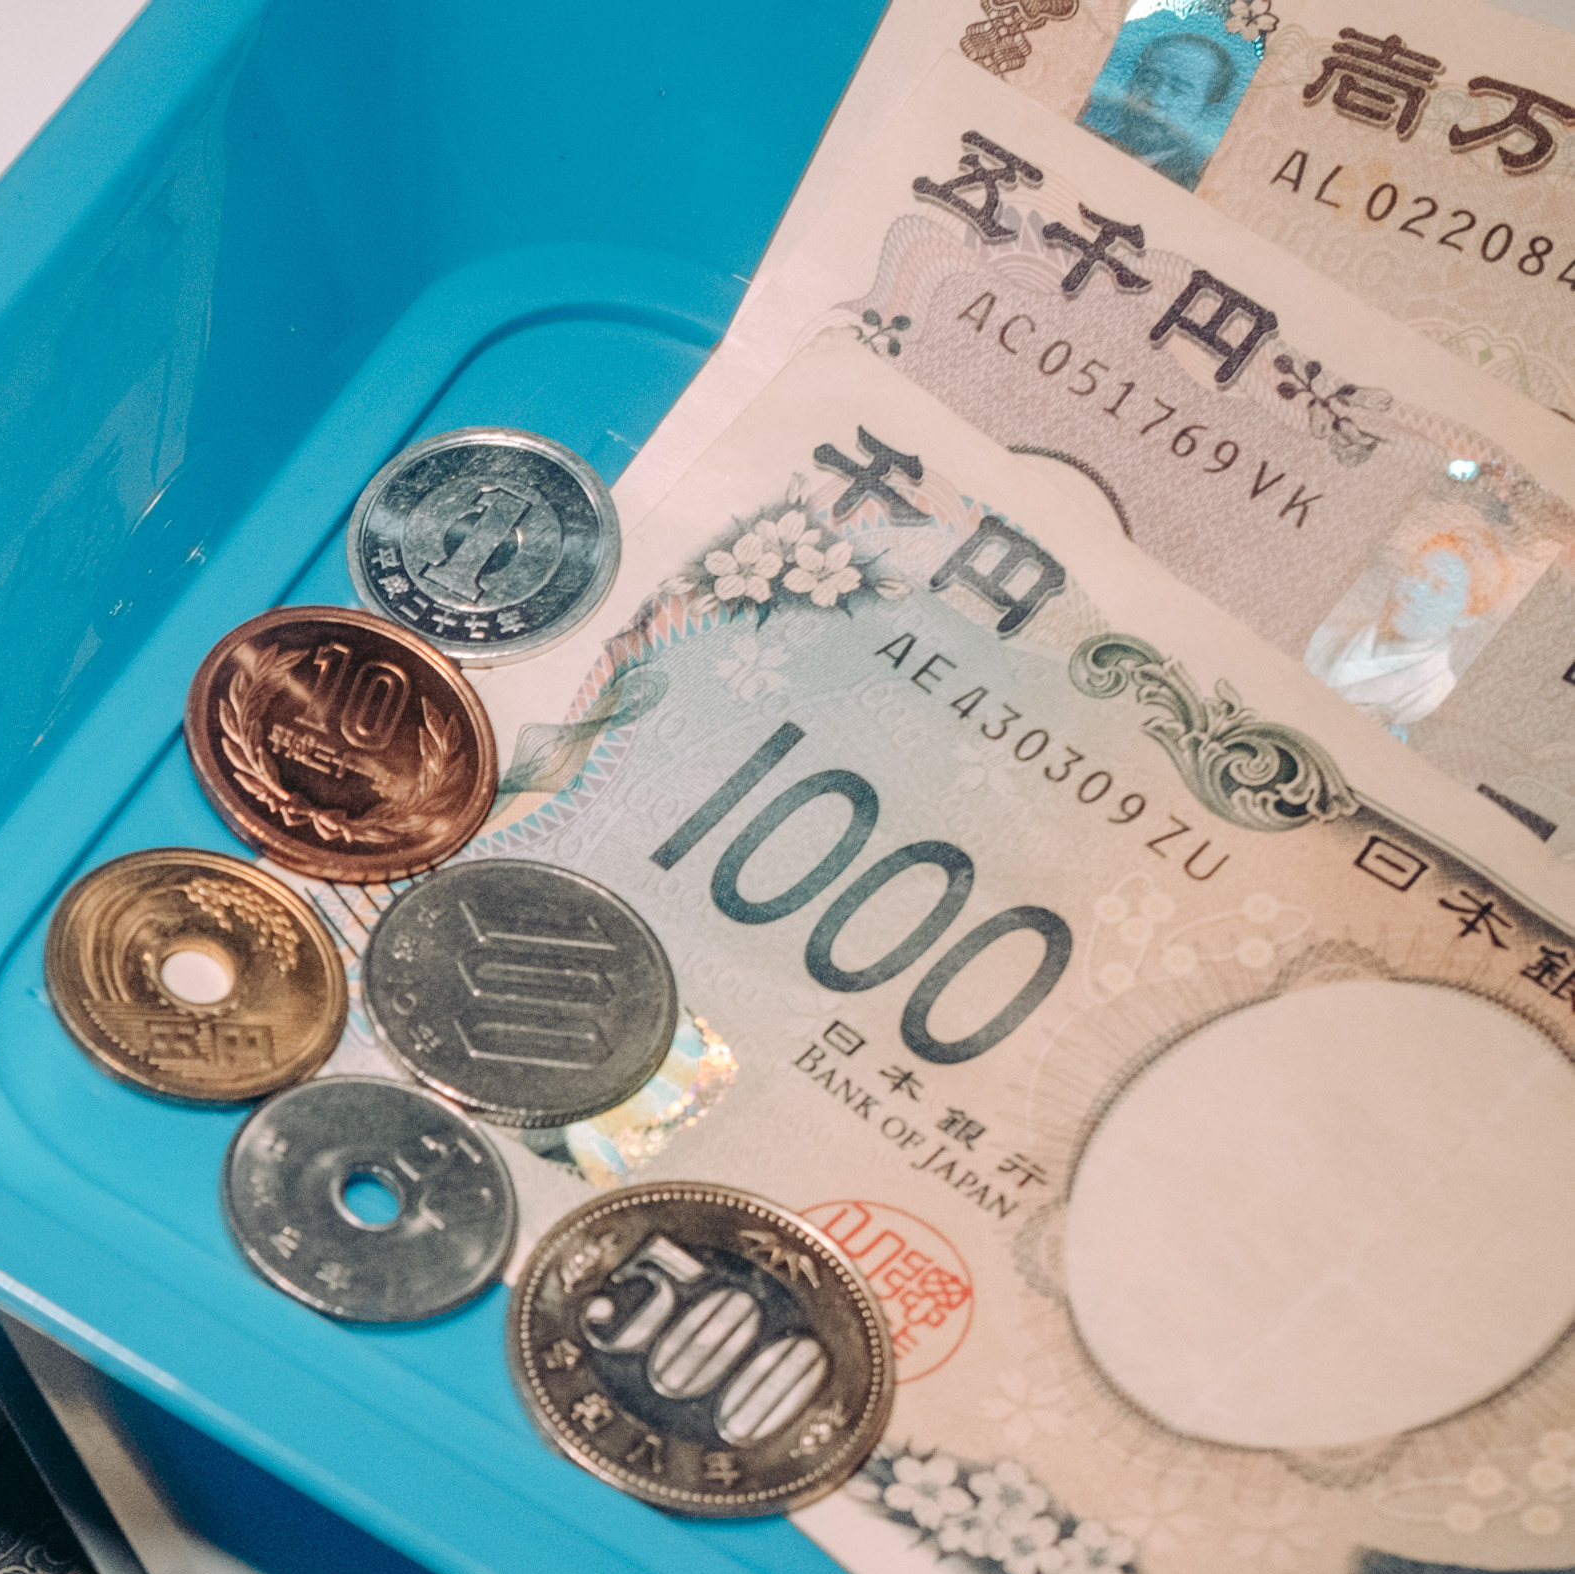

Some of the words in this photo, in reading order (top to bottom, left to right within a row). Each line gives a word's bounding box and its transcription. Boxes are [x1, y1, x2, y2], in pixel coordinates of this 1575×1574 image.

[913, 131, 1279, 390] 五千円
[956, 292, 1324, 529] AC051769VK
[813, 425, 1066, 637] 千円
[295, 642, 410, 749] 10
[875, 632, 1233, 882] AE430309ZU
[453, 898, 619, 1069] 100
[648, 720, 1072, 1065] 1000
[791, 1043, 885, 1123] BANK
[880, 1111, 921, 1150] OF
[910, 1146, 1021, 1221] JAPAN
[823, 1020, 1048, 1190] 日本銀行
[581, 1236, 829, 1448] 500
